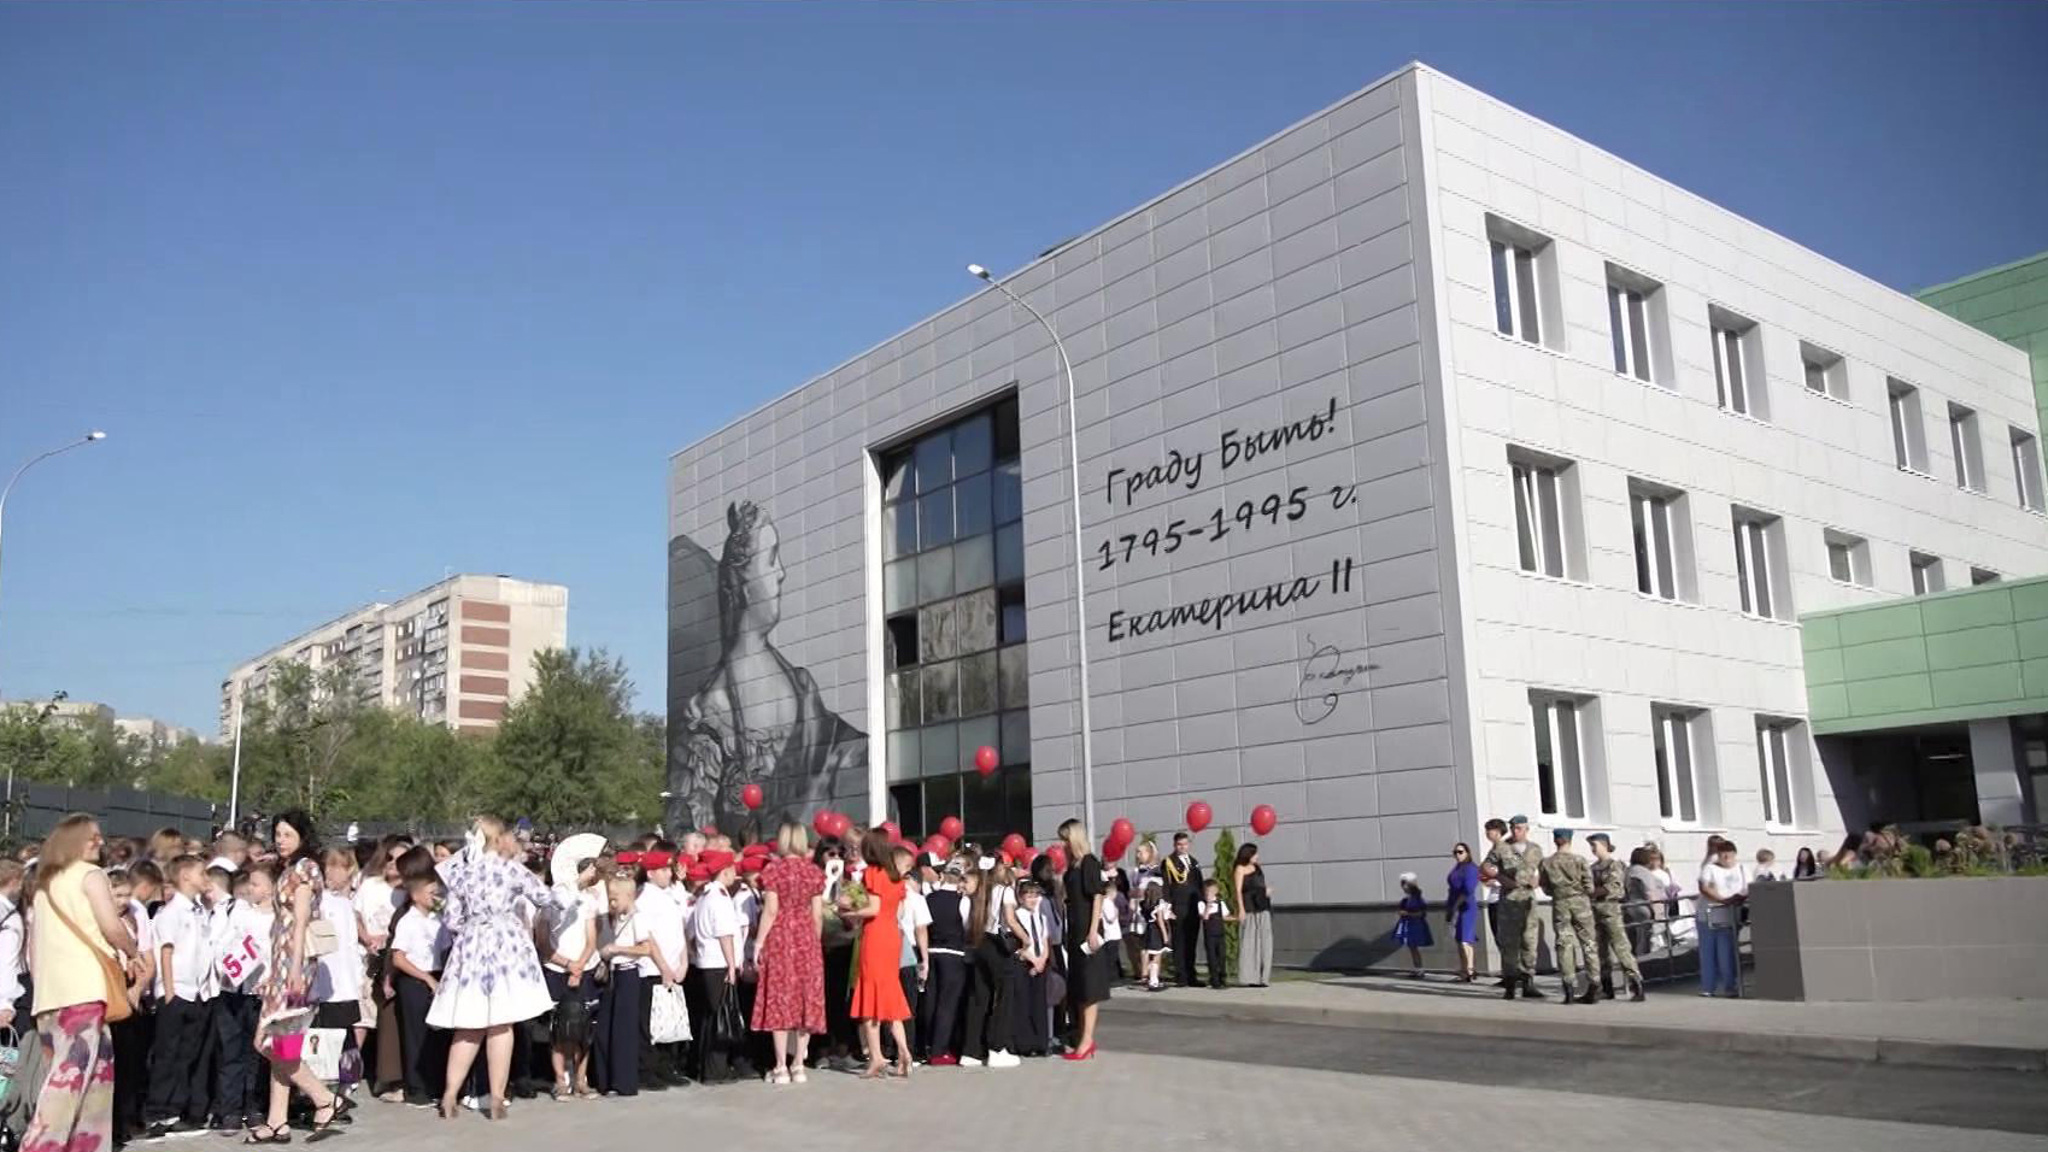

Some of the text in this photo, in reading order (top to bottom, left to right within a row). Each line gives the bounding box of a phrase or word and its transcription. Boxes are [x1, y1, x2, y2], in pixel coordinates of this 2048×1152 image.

[1106, 398, 1336, 505] Граду Быть!
[1098, 485, 1357, 569] 1795-1995 г.
[1108, 558, 1352, 642] Екатерина II
[222, 935, 257, 978] 5-Г
